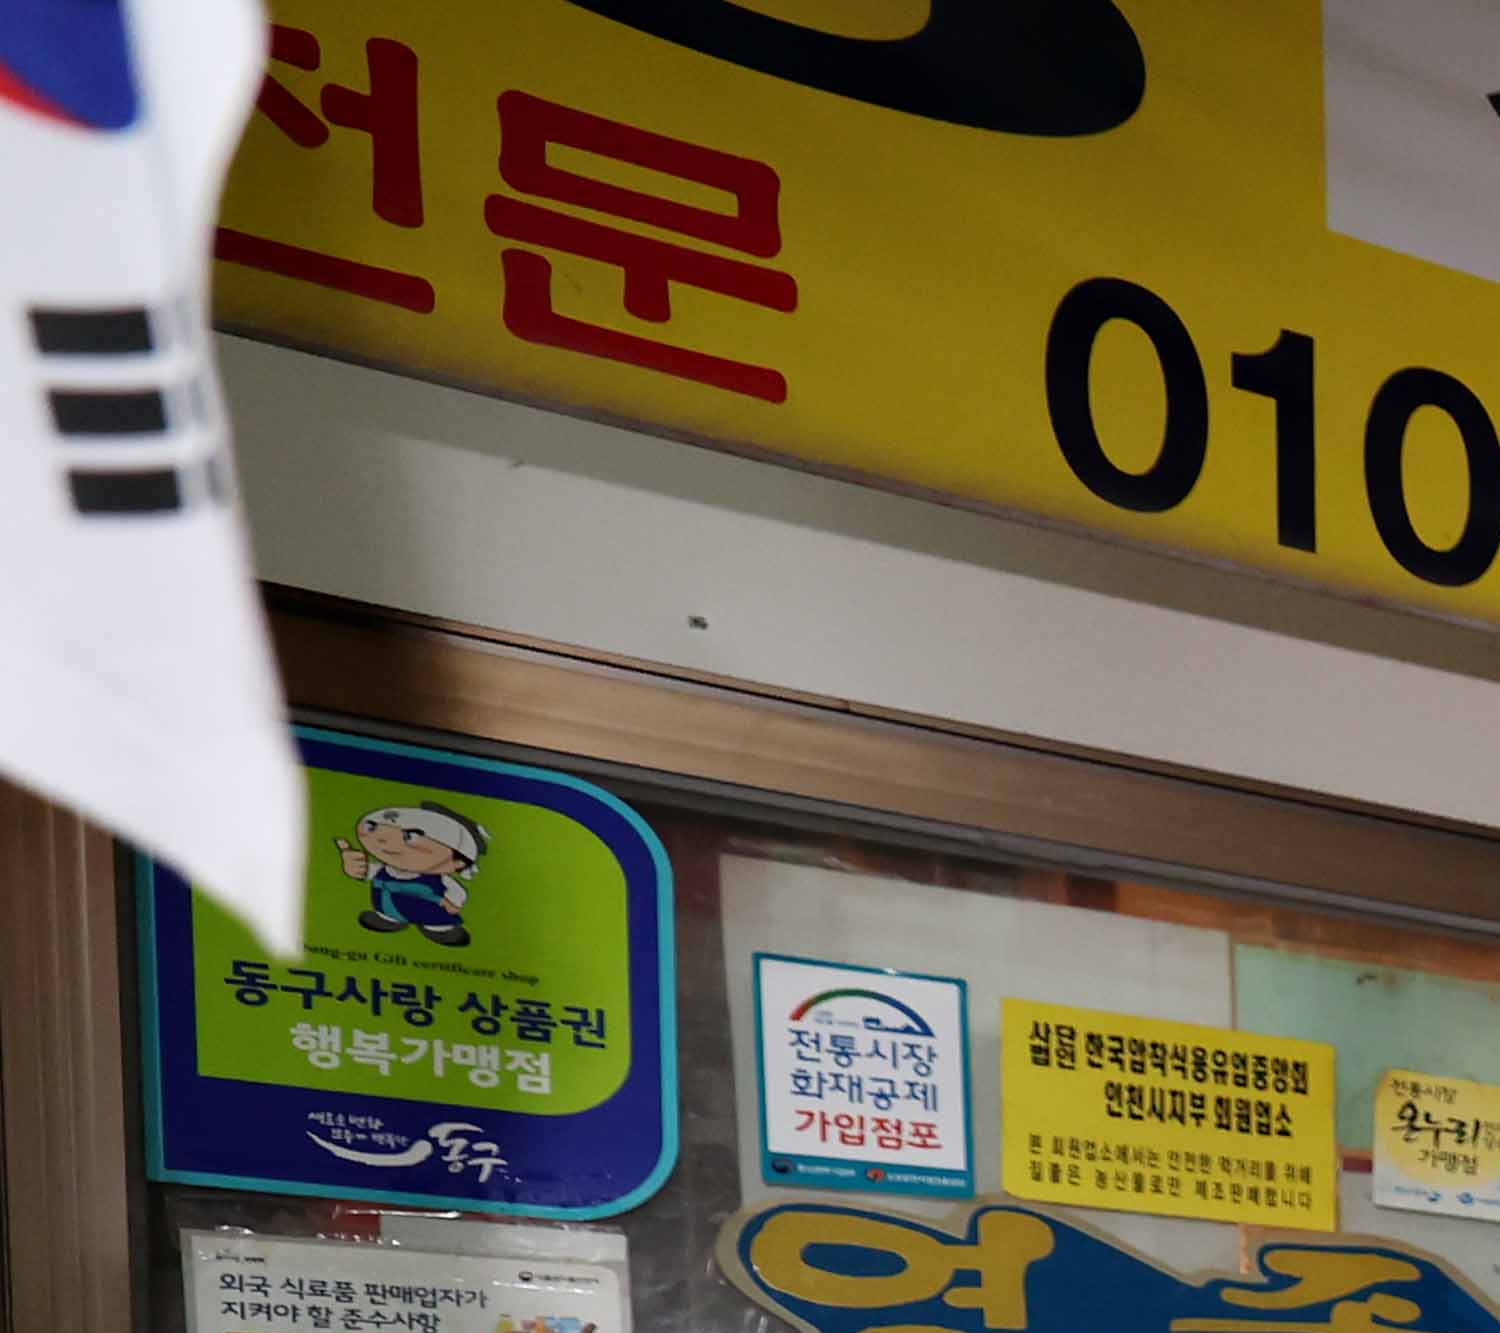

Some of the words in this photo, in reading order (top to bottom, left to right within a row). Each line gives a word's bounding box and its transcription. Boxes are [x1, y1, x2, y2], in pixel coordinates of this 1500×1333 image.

[224, 959, 441, 1028] 동구사랑
[458, 990, 607, 1048] 상품권
[289, 1022, 552, 1094] 행복가맹점
[788, 1028, 938, 1078] 전통시장
[790, 1069, 939, 1112] 화재공제
[1105, 1081, 1207, 1127] 인천시지부
[1214, 1096, 1293, 1137] 회원업소
[795, 1109, 942, 1150] 가입점포
[1390, 1101, 1481, 1147] 온누리
[219, 1273, 271, 1297] 외국
[281, 1277, 357, 1303] 식료품
[364, 1283, 488, 1311] 판매업자가
[221, 1302, 300, 1324] 지켜야
[308, 1305, 331, 1328] 할
